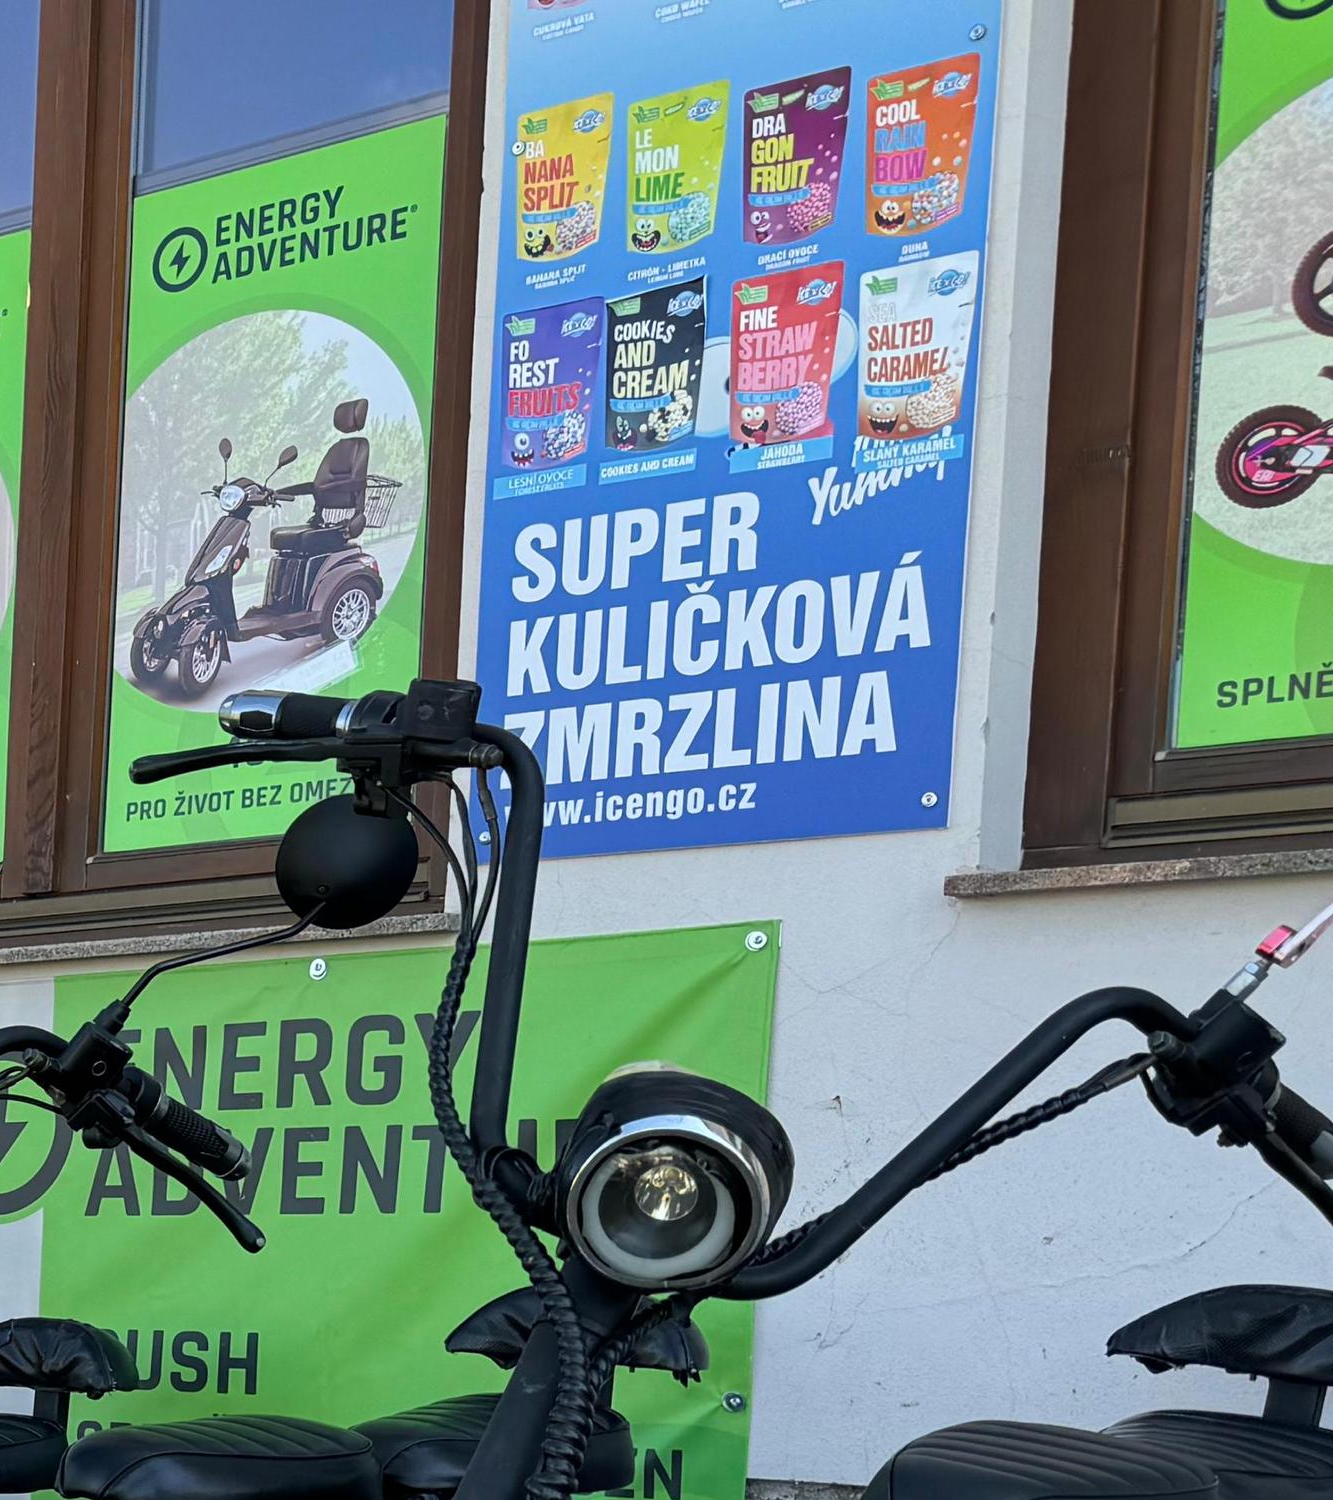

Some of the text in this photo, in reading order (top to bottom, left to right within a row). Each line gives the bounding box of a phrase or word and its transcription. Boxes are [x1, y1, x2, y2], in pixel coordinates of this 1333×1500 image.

[752, 113, 786, 139] DRA
[875, 99, 920, 127] COOL
[525, 140, 544, 159] BA
[635, 128, 653, 149] LE
[751, 133, 795, 165] GON
[874, 120, 926, 154] RAIN
[524, 153, 574, 185] NANA
[635, 144, 680, 175] MON
[874, 148, 928, 183] BOW
[635, 172, 685, 202] LIME
[750, 158, 815, 193] FRUIT
[523, 181, 579, 212] SPLIT
[215, 185, 345, 247] ENERGY
[788, 244, 819, 262] OVOCE
[901, 241, 929, 255] DUHA
[562, 264, 586, 278] SPLIT
[667, 256, 706, 274] LIMETKA
[739, 306, 778, 332] FINE
[868, 302, 897, 323] SEA
[614, 319, 676, 344] COOKIES
[739, 321, 817, 361] STRAW
[867, 316, 934, 352] SALTED
[510, 340, 530, 362] FO
[614, 340, 656, 369] AND
[867, 347, 950, 383] CARAMEL
[509, 357, 559, 389] REST
[613, 359, 690, 400] CREAM
[739, 353, 814, 391] BERRY
[508, 381, 582, 417] FRUITS
[760, 443, 803, 461] JAHODA
[903, 437, 957, 457] KARAMEL
[538, 469, 573, 485] OVOCE
[601, 454, 694, 479] COOKIES AND CREAM
[511, 490, 761, 604] SUPER
[505, 549, 933, 698] KULIČKOVÁ
[126, 784, 282, 822] PRO ŽIVOT BEZ
